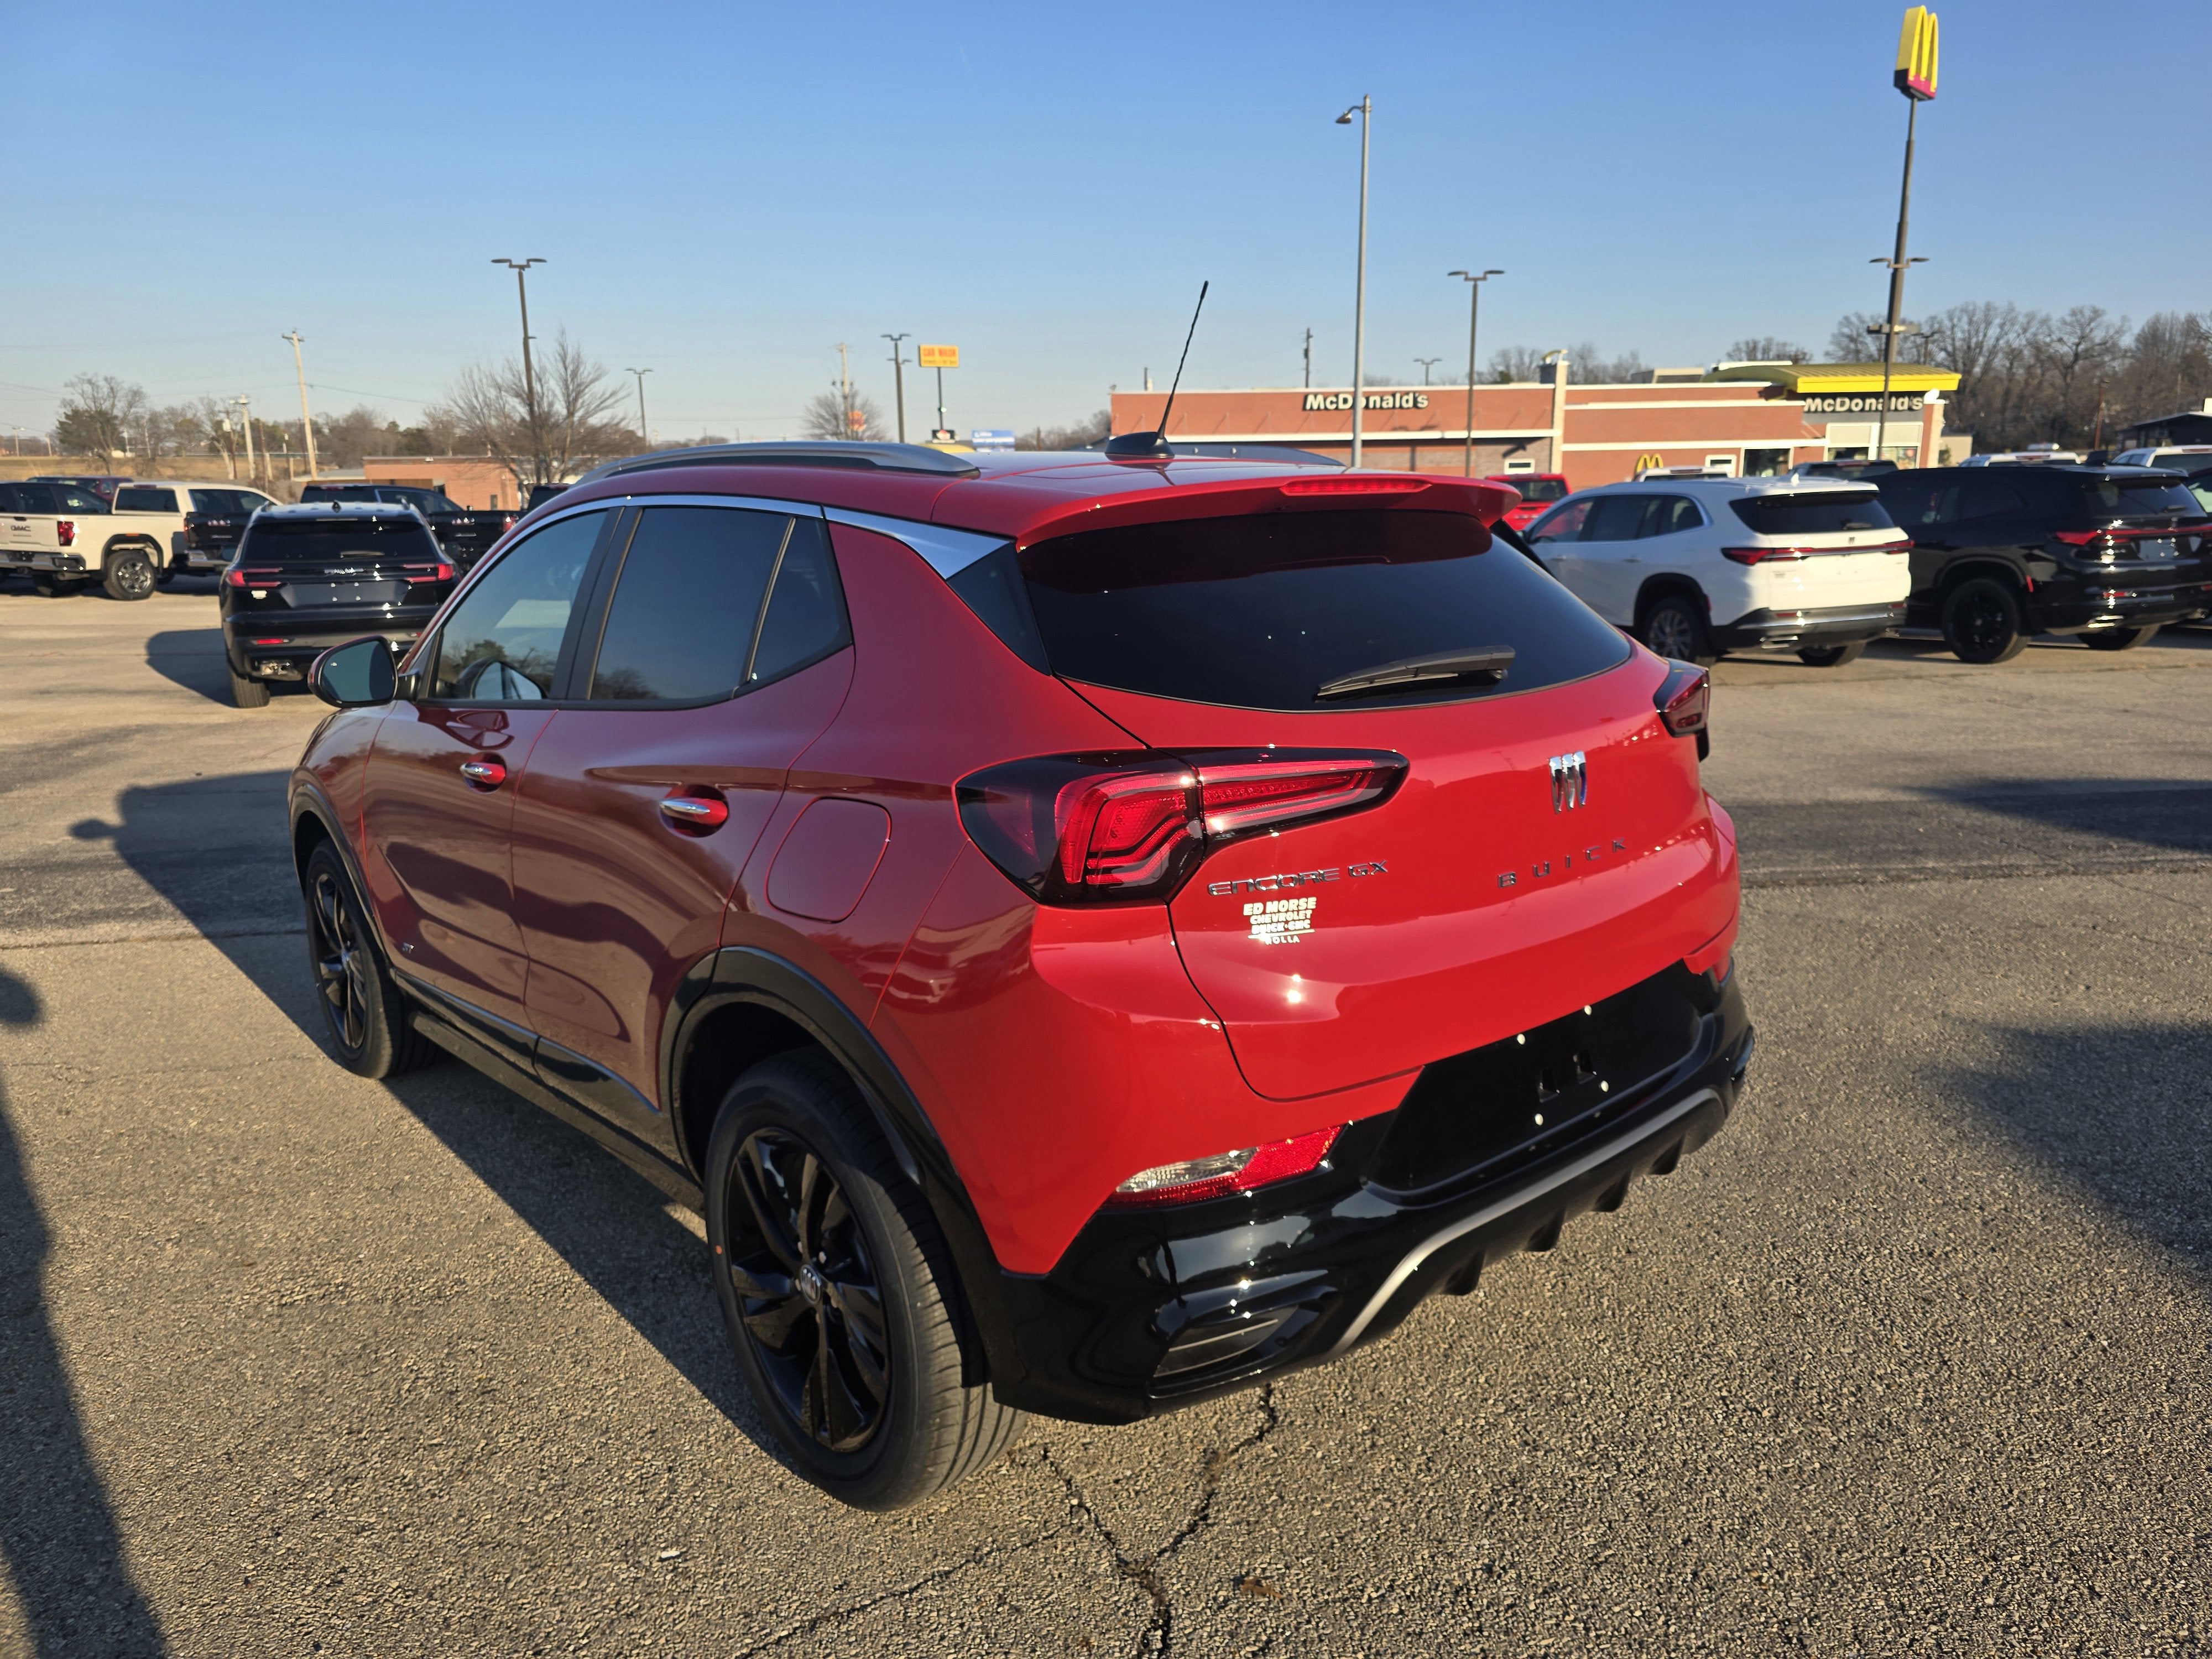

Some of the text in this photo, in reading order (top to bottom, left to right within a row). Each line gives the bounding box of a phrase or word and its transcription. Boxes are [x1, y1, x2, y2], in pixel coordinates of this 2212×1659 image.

[1497, 837, 1627, 888] BUICK
[1208, 859, 1389, 896] ENCORE GX
[1243, 896, 1317, 916] ED MORSE
[1250, 909, 1313, 925] CHEVROLET
